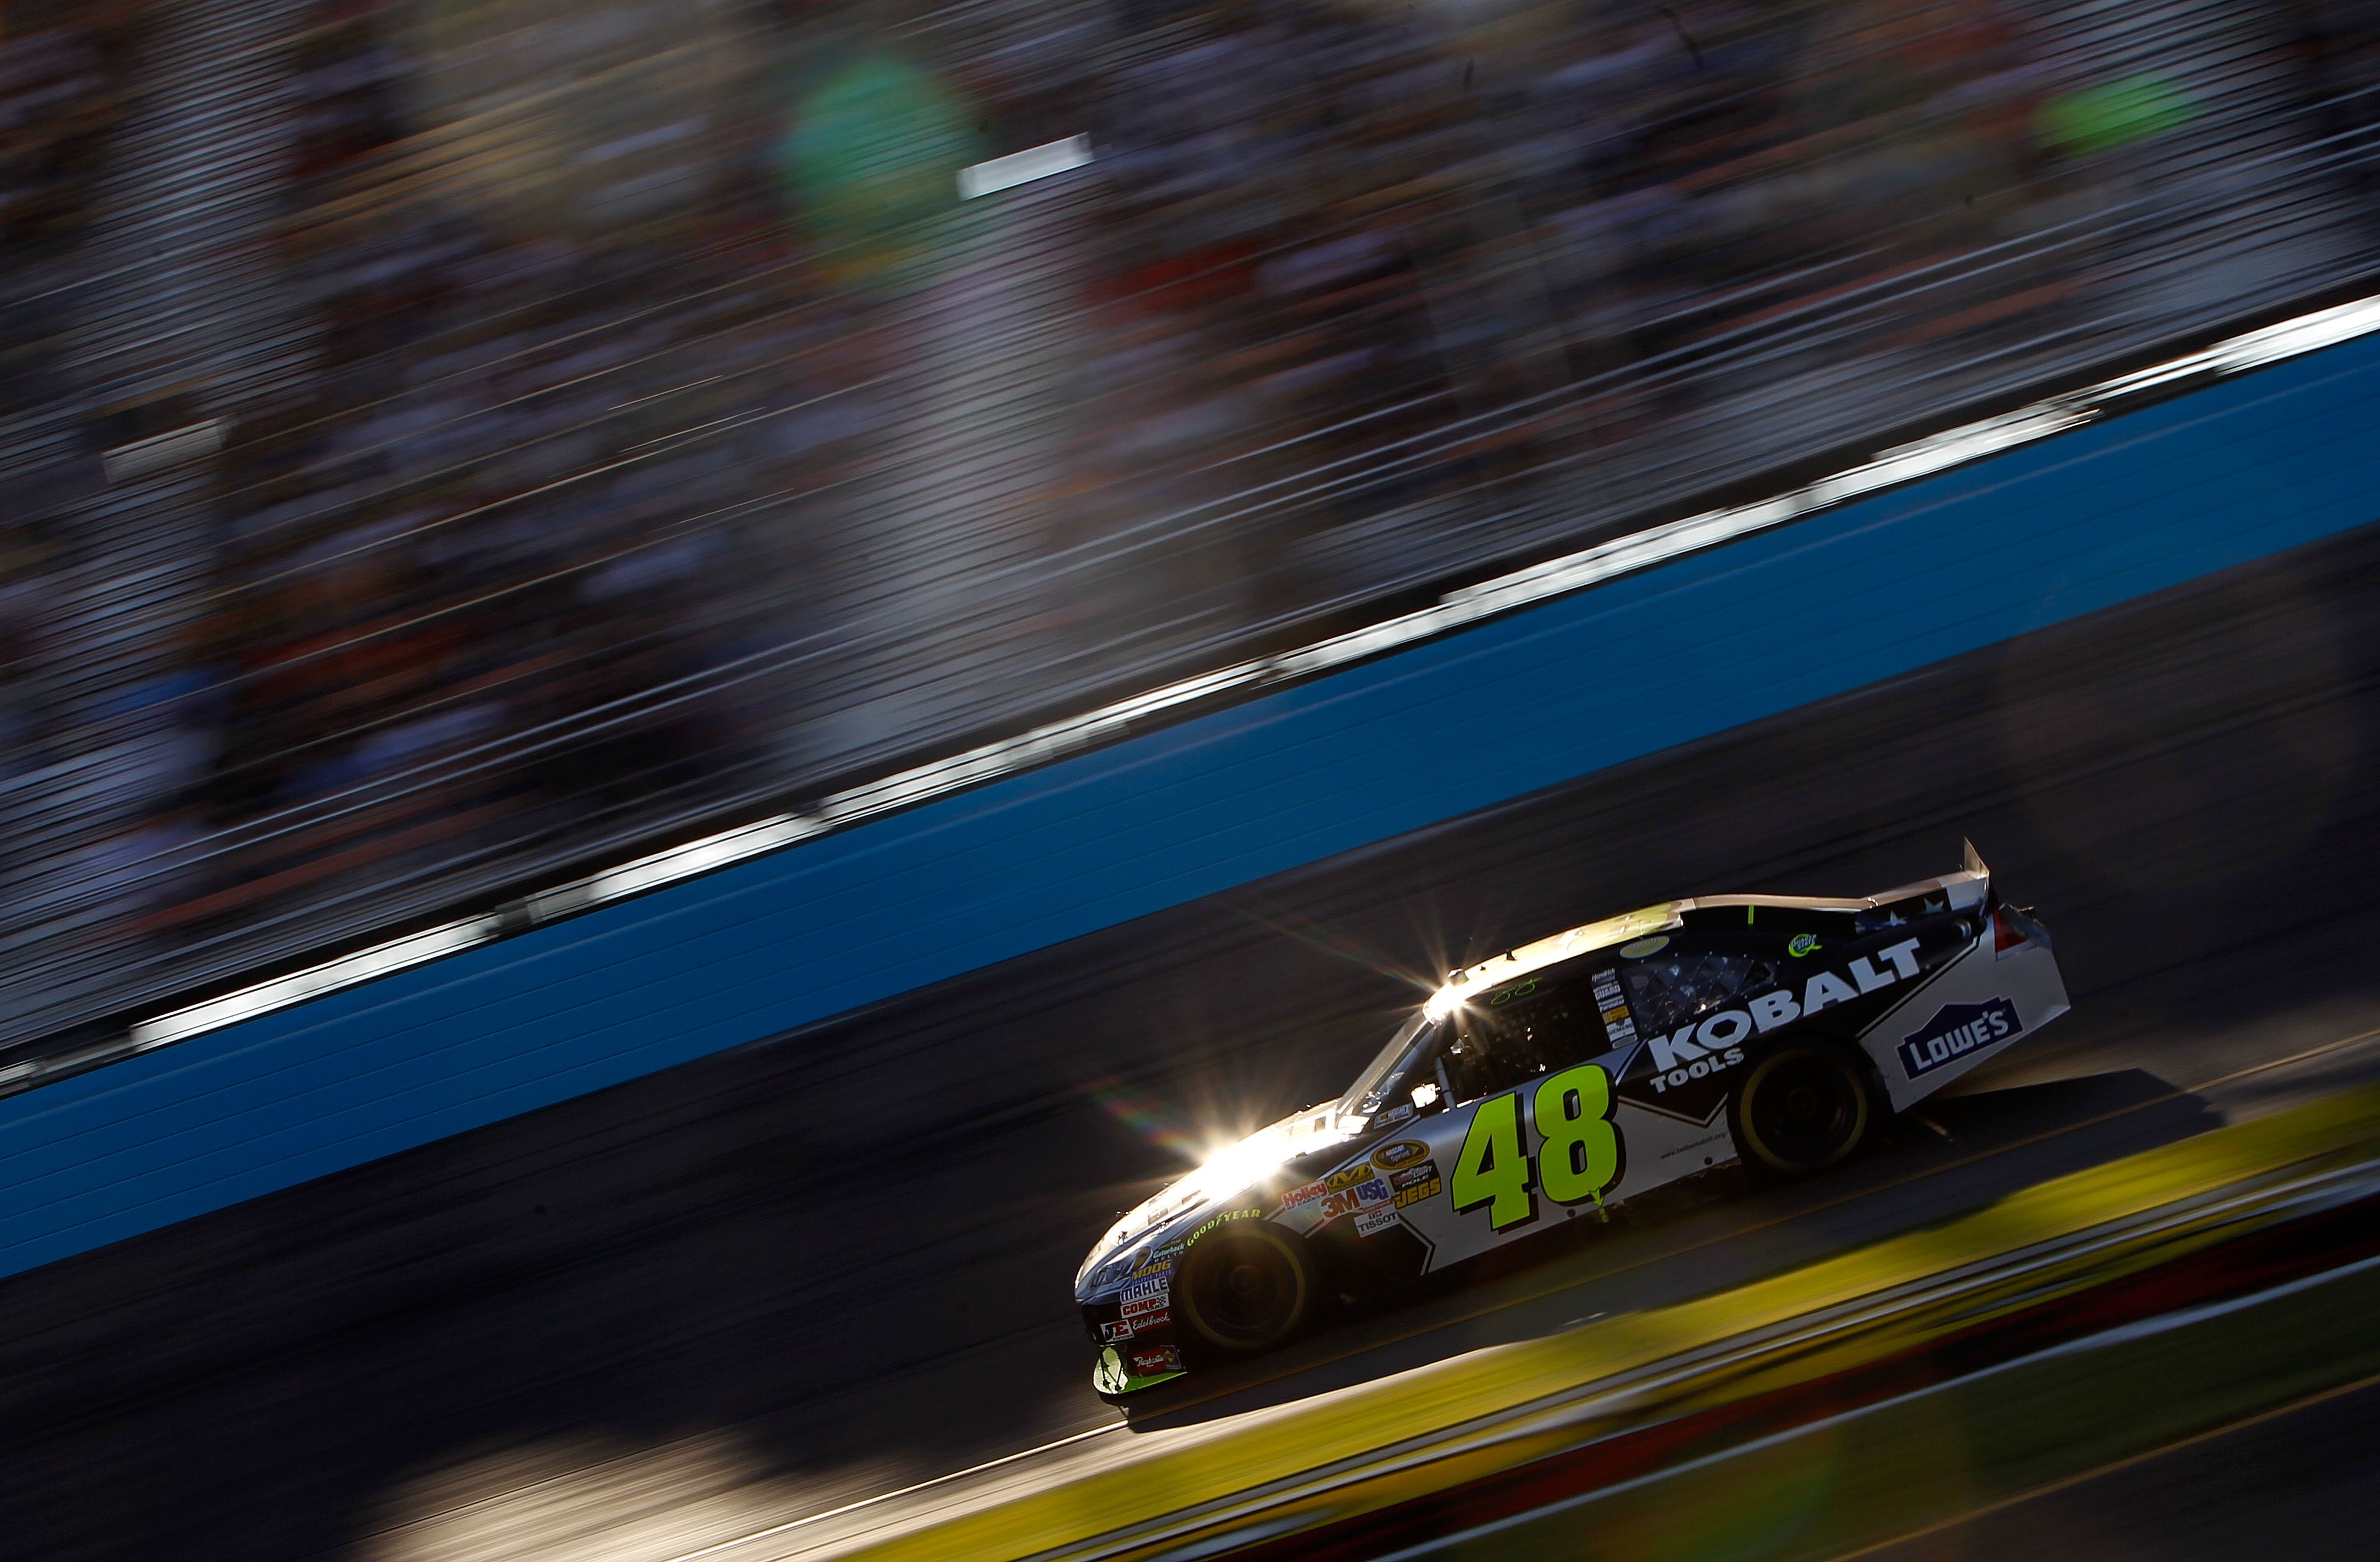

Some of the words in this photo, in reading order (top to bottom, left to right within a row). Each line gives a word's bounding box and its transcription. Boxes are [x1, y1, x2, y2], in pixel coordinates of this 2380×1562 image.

[1648, 937, 1921, 1073] KOBALT
[1909, 1010, 2008, 1071] LOWE'S
[1650, 1047, 1745, 1093] TOOLS
[1390, 1150, 1411, 1163] Sprint
[1450, 1063, 1620, 1231] 48
[1282, 1182, 1328, 1207] Holley
[1356, 1178, 1388, 1200] USG
[1395, 1177, 1441, 1209] JEGS
[1321, 1188, 1360, 1217] 3M
[1186, 1209, 1261, 1247] GOODYEAR
[1358, 1212, 1398, 1232] TISSOT
[1133, 1259, 1172, 1280] MOOG
[1122, 1277, 1167, 1301] MAHLE
[1123, 1298, 1156, 1315] COMP
[1105, 1321, 1129, 1340] JE
[1133, 1312, 1171, 1330] Edelbrock
